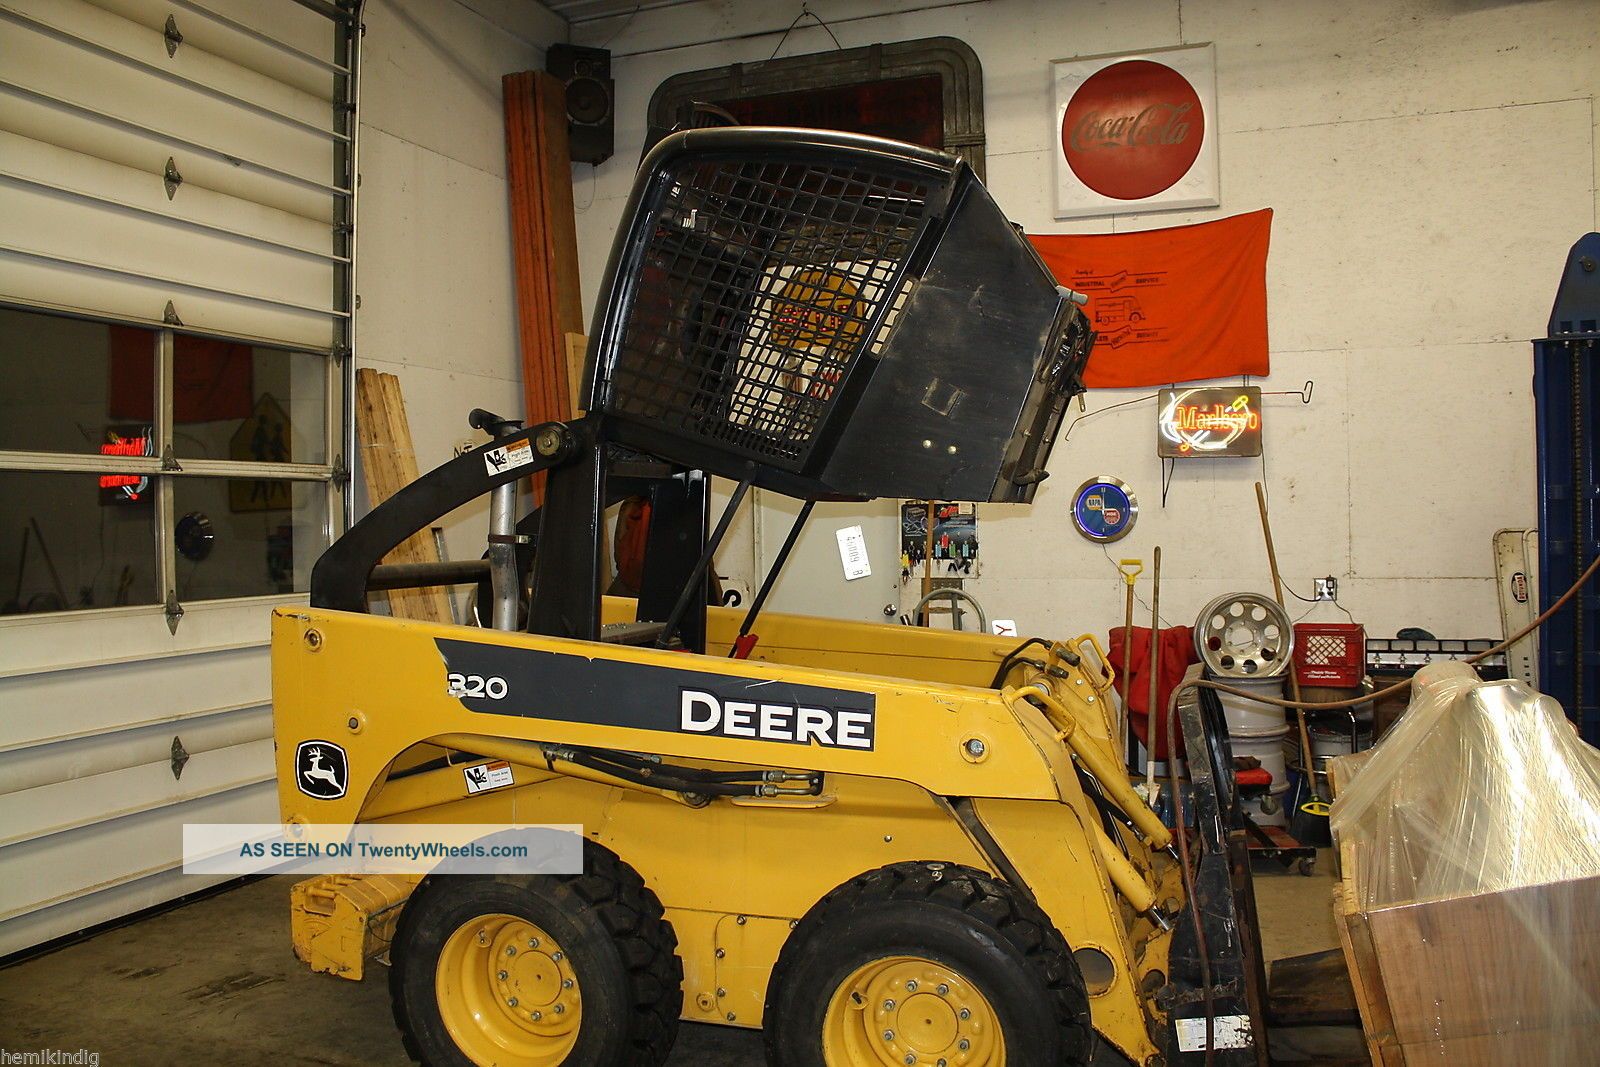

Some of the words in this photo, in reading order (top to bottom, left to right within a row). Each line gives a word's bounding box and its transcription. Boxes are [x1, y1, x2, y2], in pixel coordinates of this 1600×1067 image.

[1176, 404, 1258, 430] Marlboro
[447, 672, 509, 700] 320
[681, 690, 872, 748] DEERE
